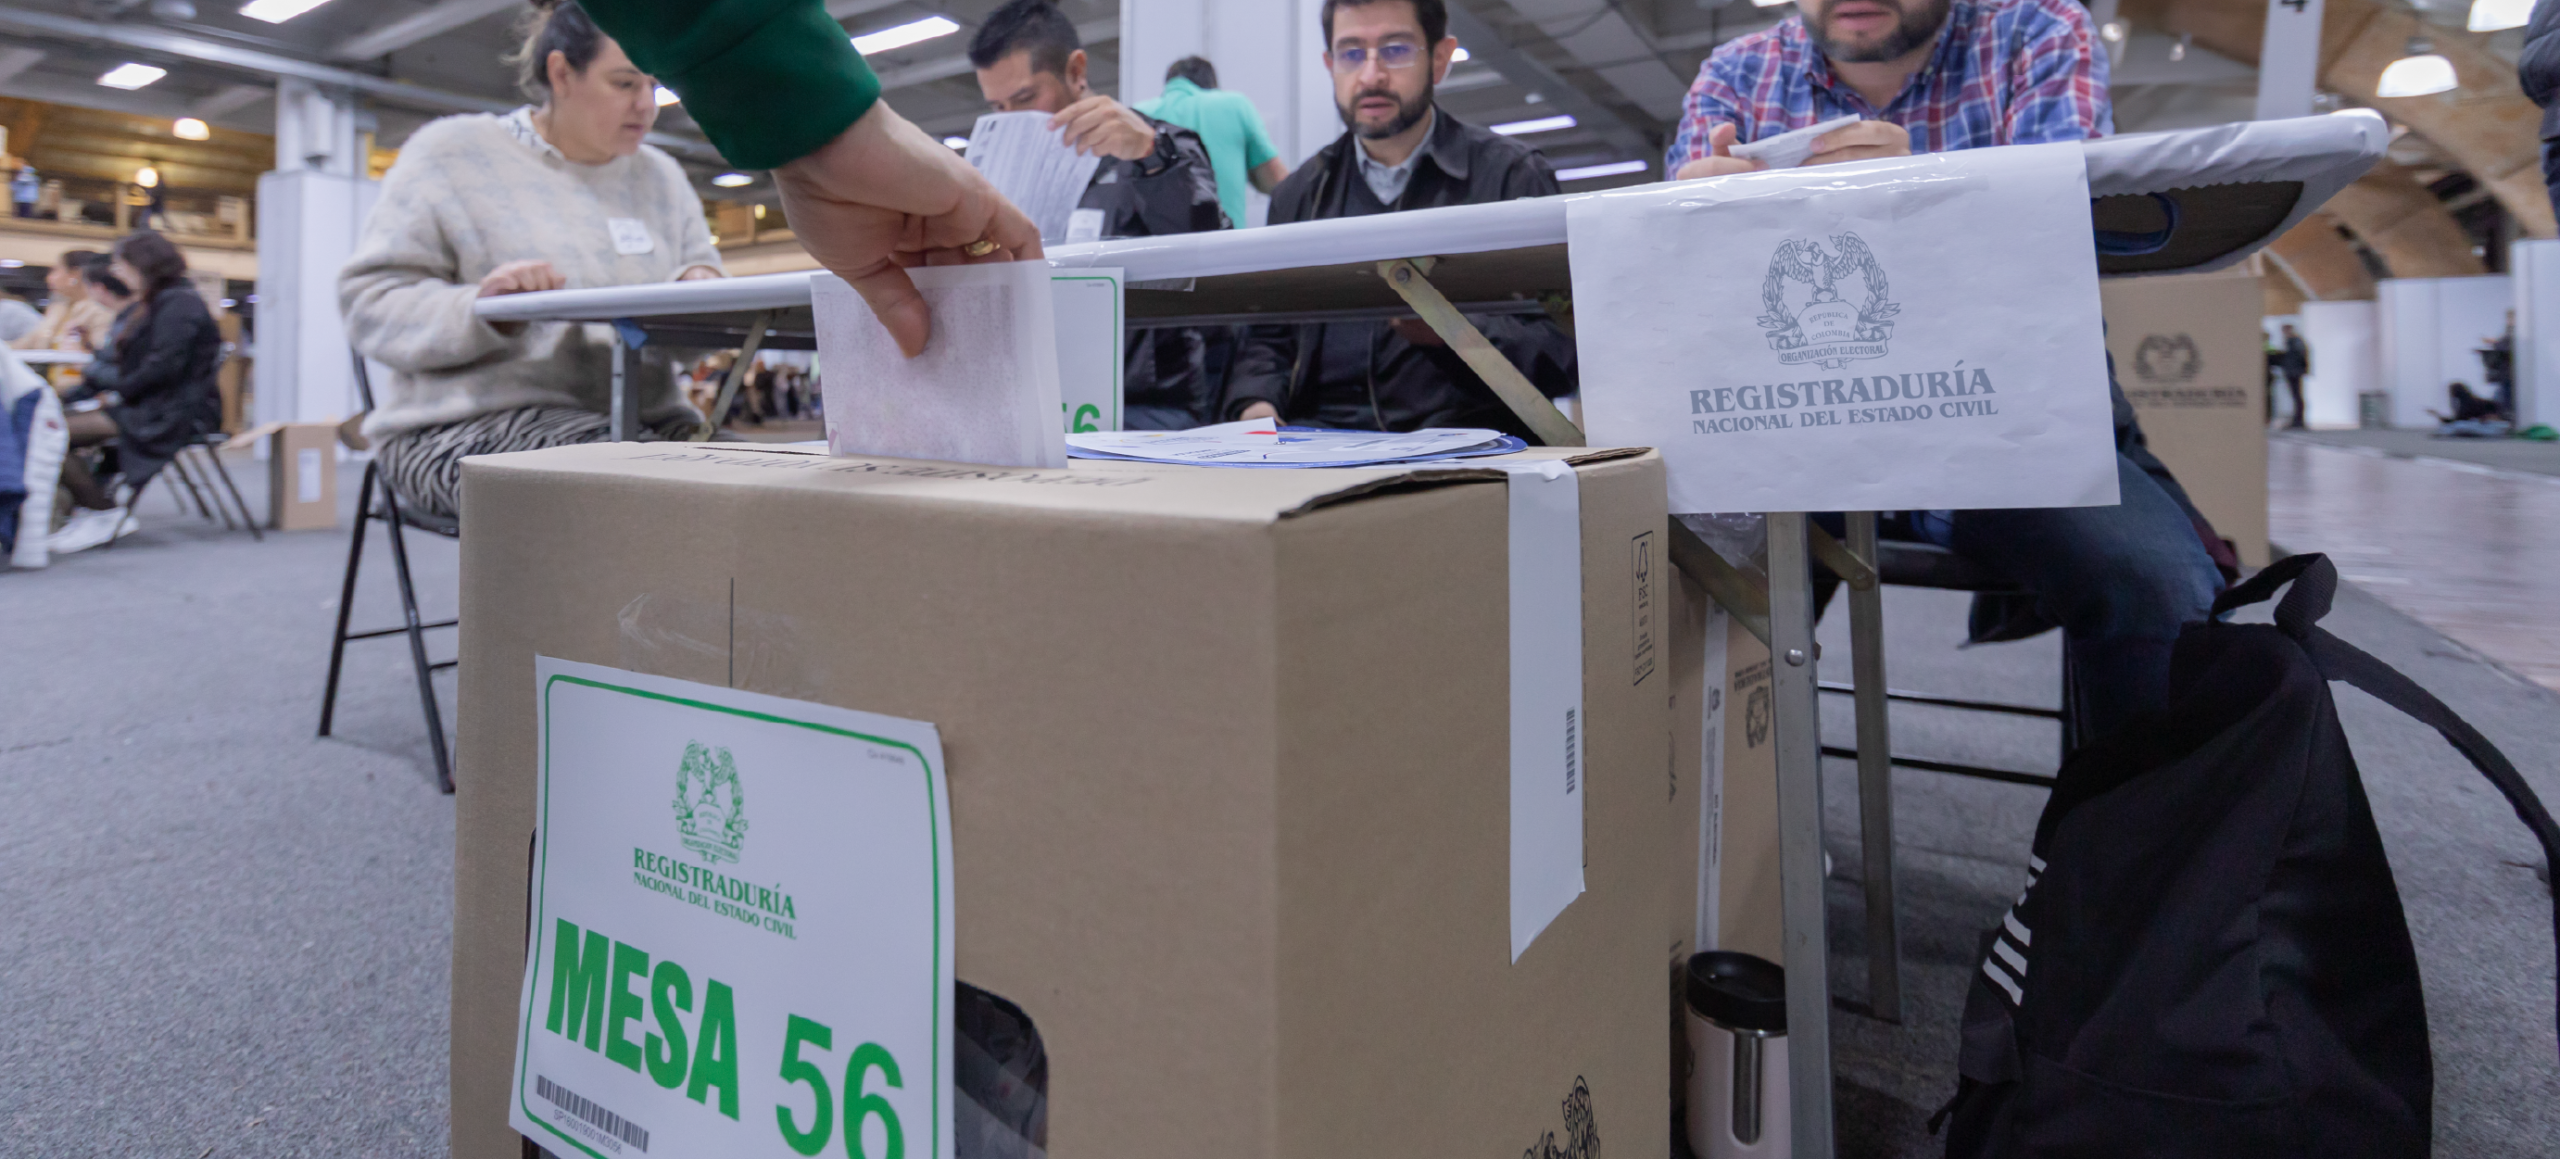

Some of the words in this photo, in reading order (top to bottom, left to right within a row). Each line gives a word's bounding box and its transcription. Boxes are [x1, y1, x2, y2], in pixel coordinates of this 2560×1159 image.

[1808, 311, 1848, 324] REPÚBLICA
[1811, 329, 1851, 341] COLOMBIA
[1780, 344, 1838, 362] ORGANIZACIÓN
[1839, 344, 1885, 355] ELECTORAL
[1689, 360, 1996, 415] REGISTRADURÍA
[1062, 403, 1100, 433] 6
[1692, 414, 1793, 434] NACIONAL
[1800, 410, 1842, 428] DEL
[1848, 404, 1933, 424] ESTADO
[1939, 400, 1999, 418] CIVIL
[633, 847, 797, 921] REGISTRADURÍA
[633, 871, 686, 901] NACIONAL
[688, 890, 711, 910] DEL
[714, 899, 760, 928] ESTADO
[763, 916, 797, 940] CIVIL
[546, 917, 740, 1122] MESA
[776, 1013, 905, 1159] 56
